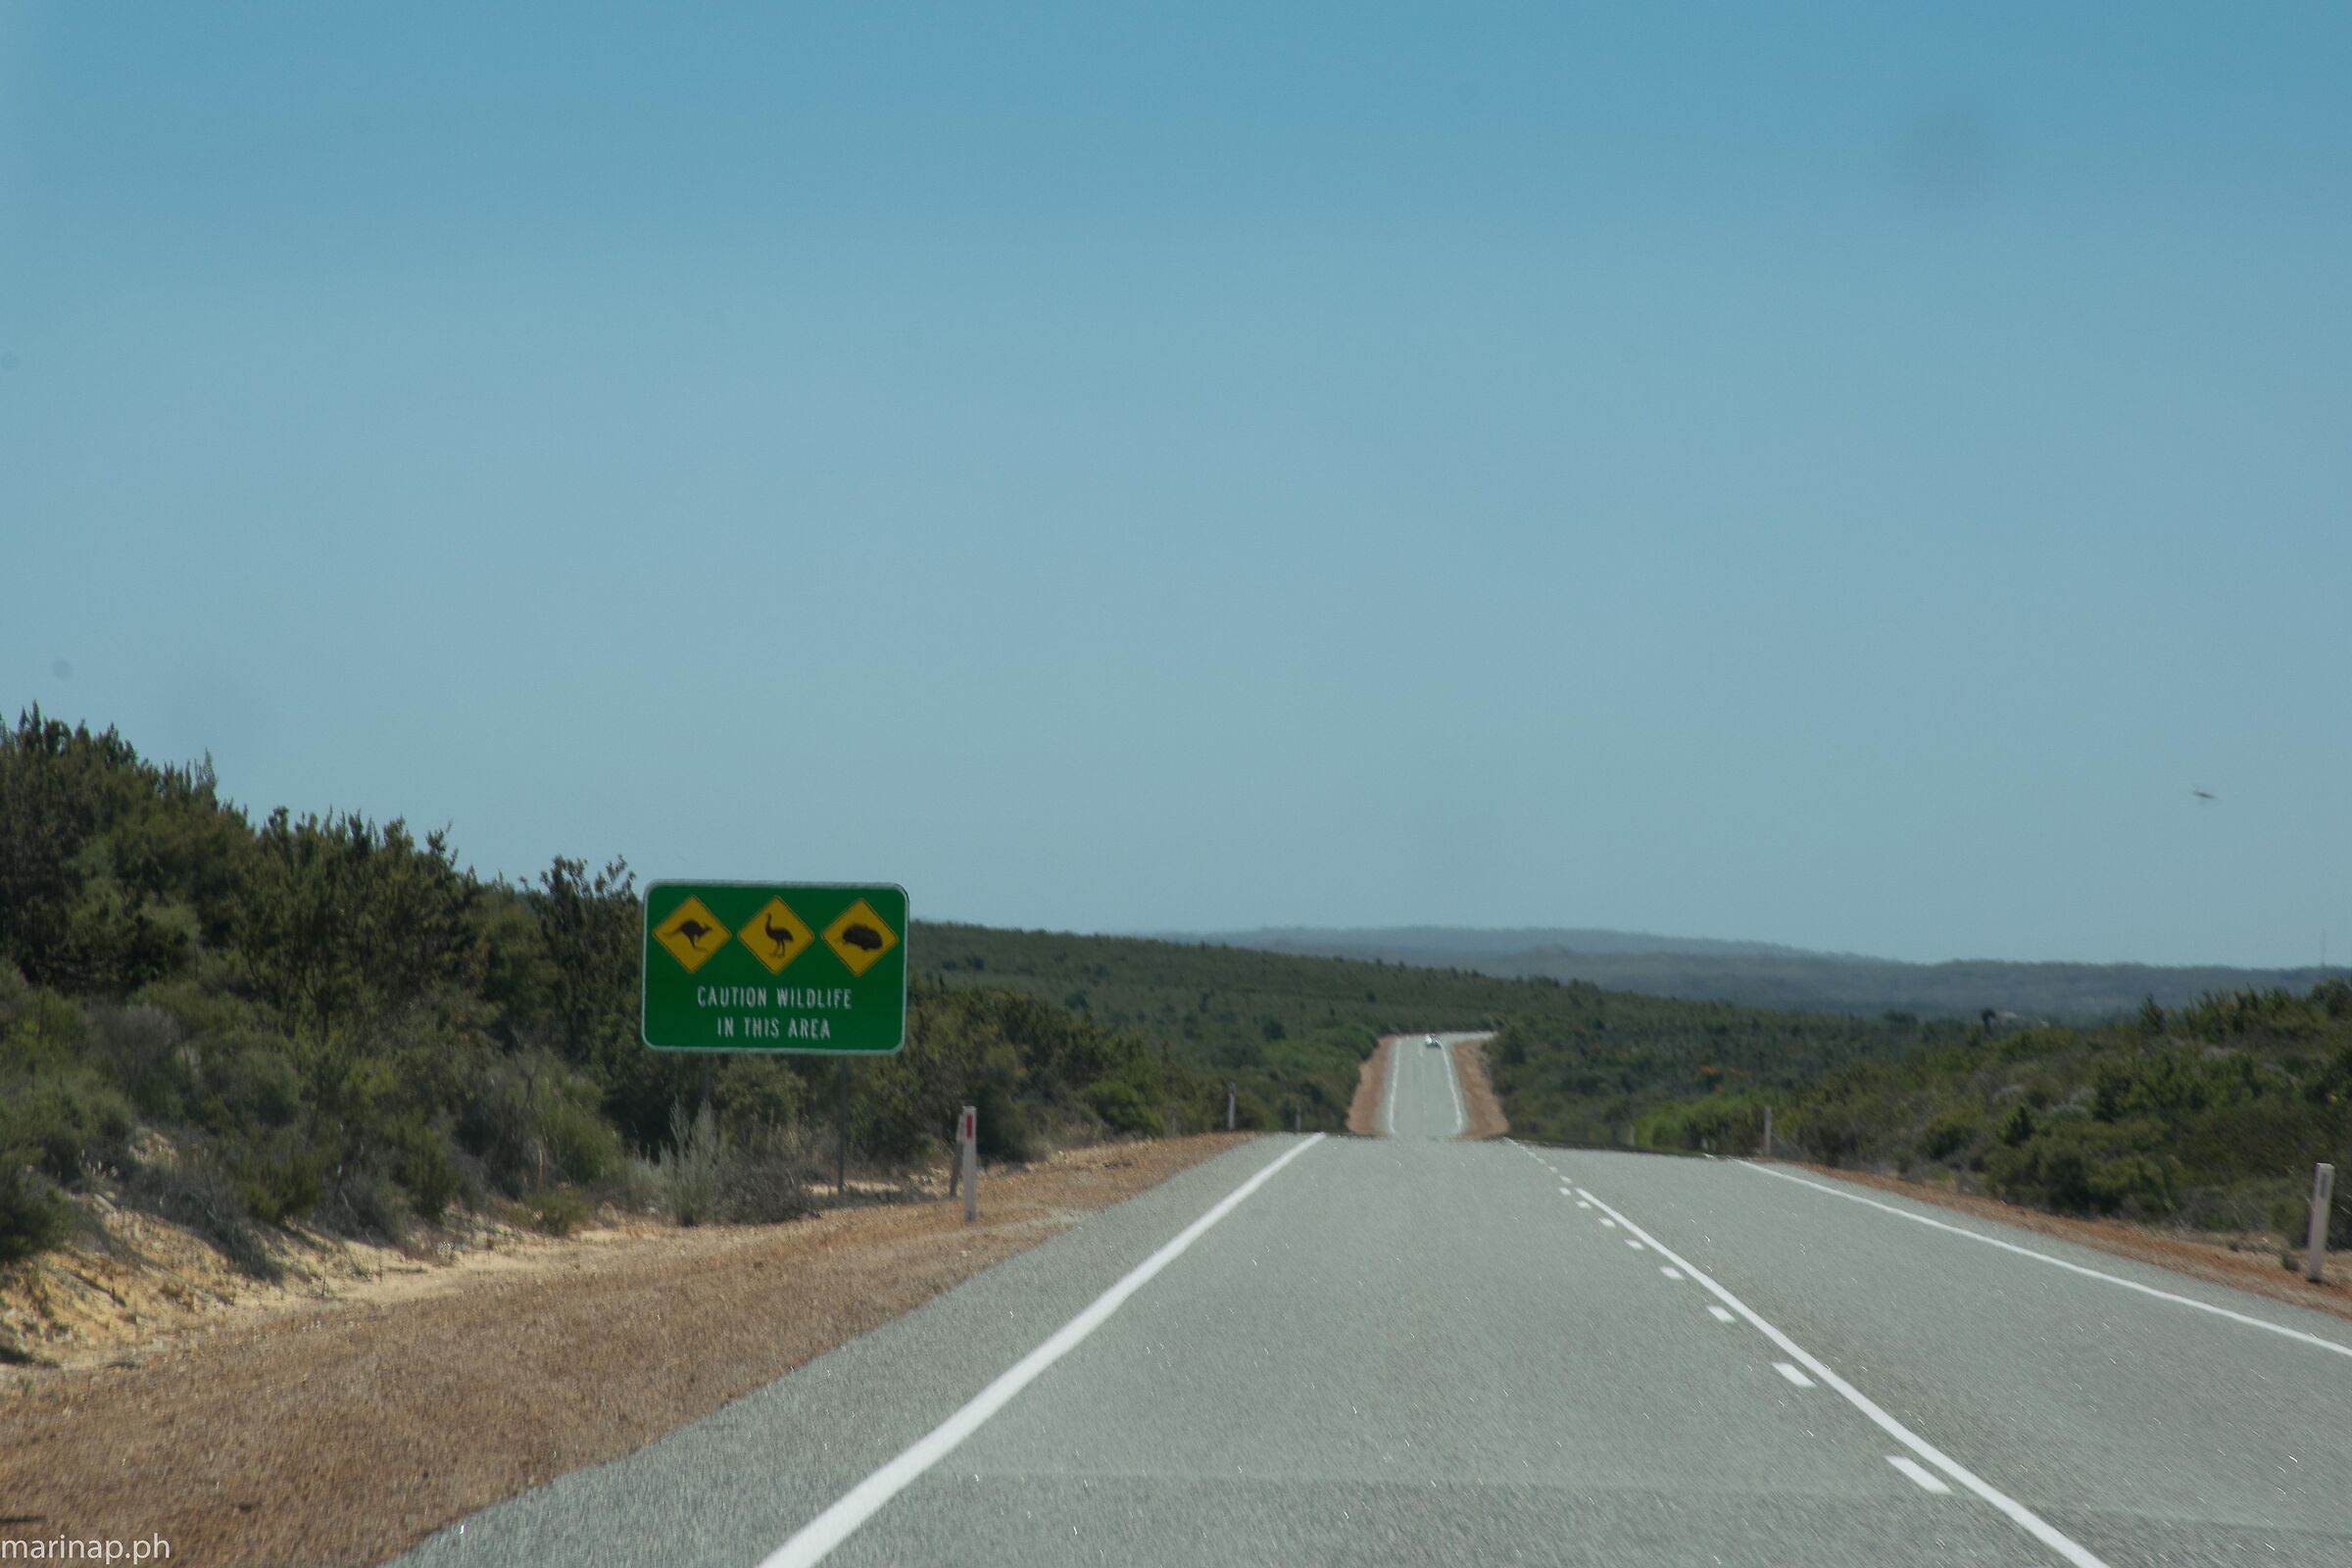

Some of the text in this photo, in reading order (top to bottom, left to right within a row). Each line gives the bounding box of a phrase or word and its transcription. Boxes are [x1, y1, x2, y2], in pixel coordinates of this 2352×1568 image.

[697, 986, 853, 1009] CAUTION WILDLIFE
[717, 1016, 831, 1040] IN THIS AREA
